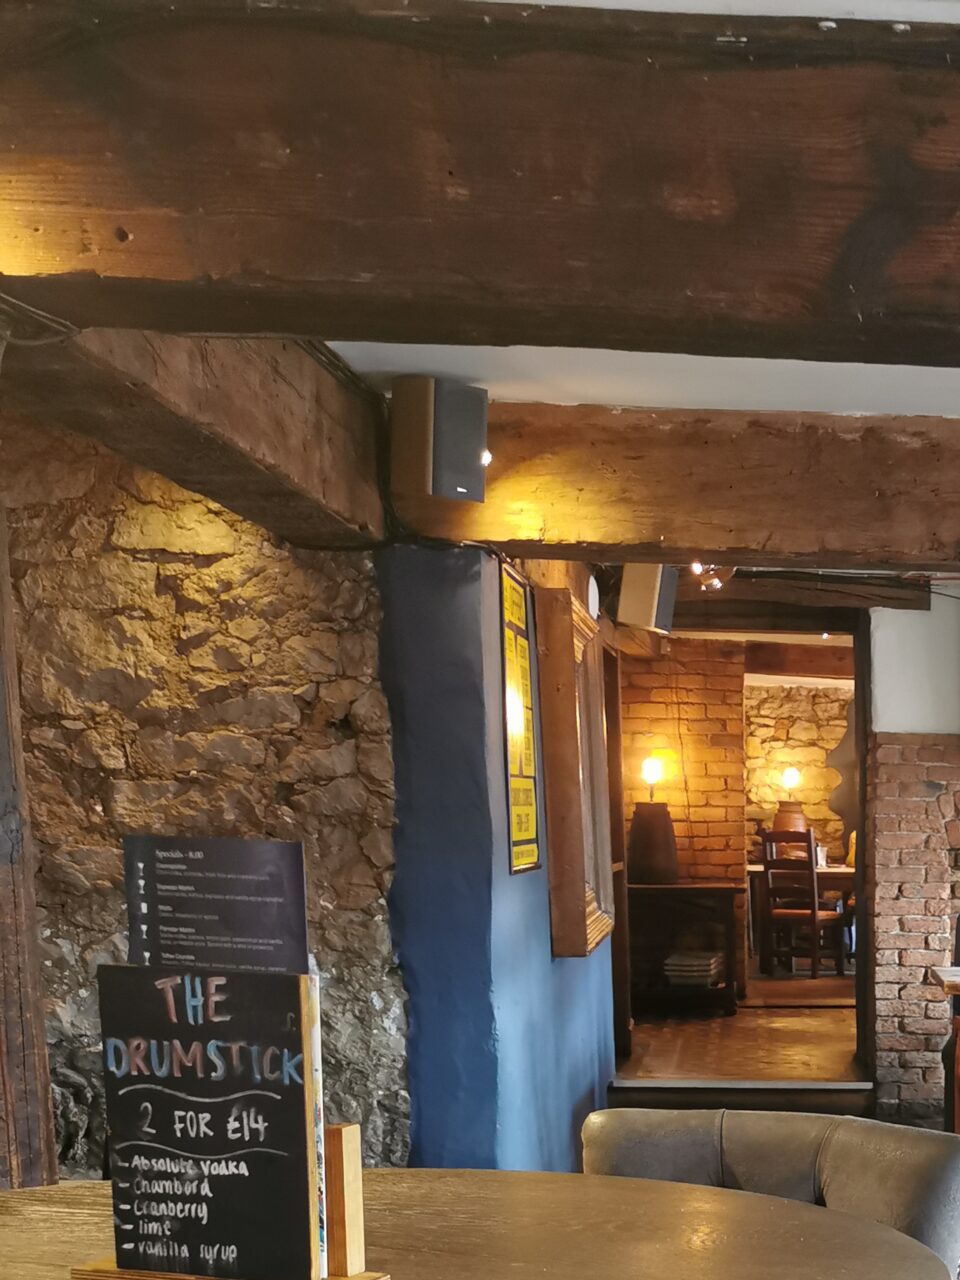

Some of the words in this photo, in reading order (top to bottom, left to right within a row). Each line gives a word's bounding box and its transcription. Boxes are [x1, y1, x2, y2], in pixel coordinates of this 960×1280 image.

[155, 975, 231, 1025] THE
[105, 1037, 304, 1085] DRUMSTICK
[140, 1102, 156, 1133] 2
[173, 1110, 214, 1138] FOR
[227, 1108, 268, 1141] £14
[133, 1177, 213, 1197] Chambord
[134, 1200, 208, 1225] Cranberry
[200, 1244, 237, 1264] syrup
